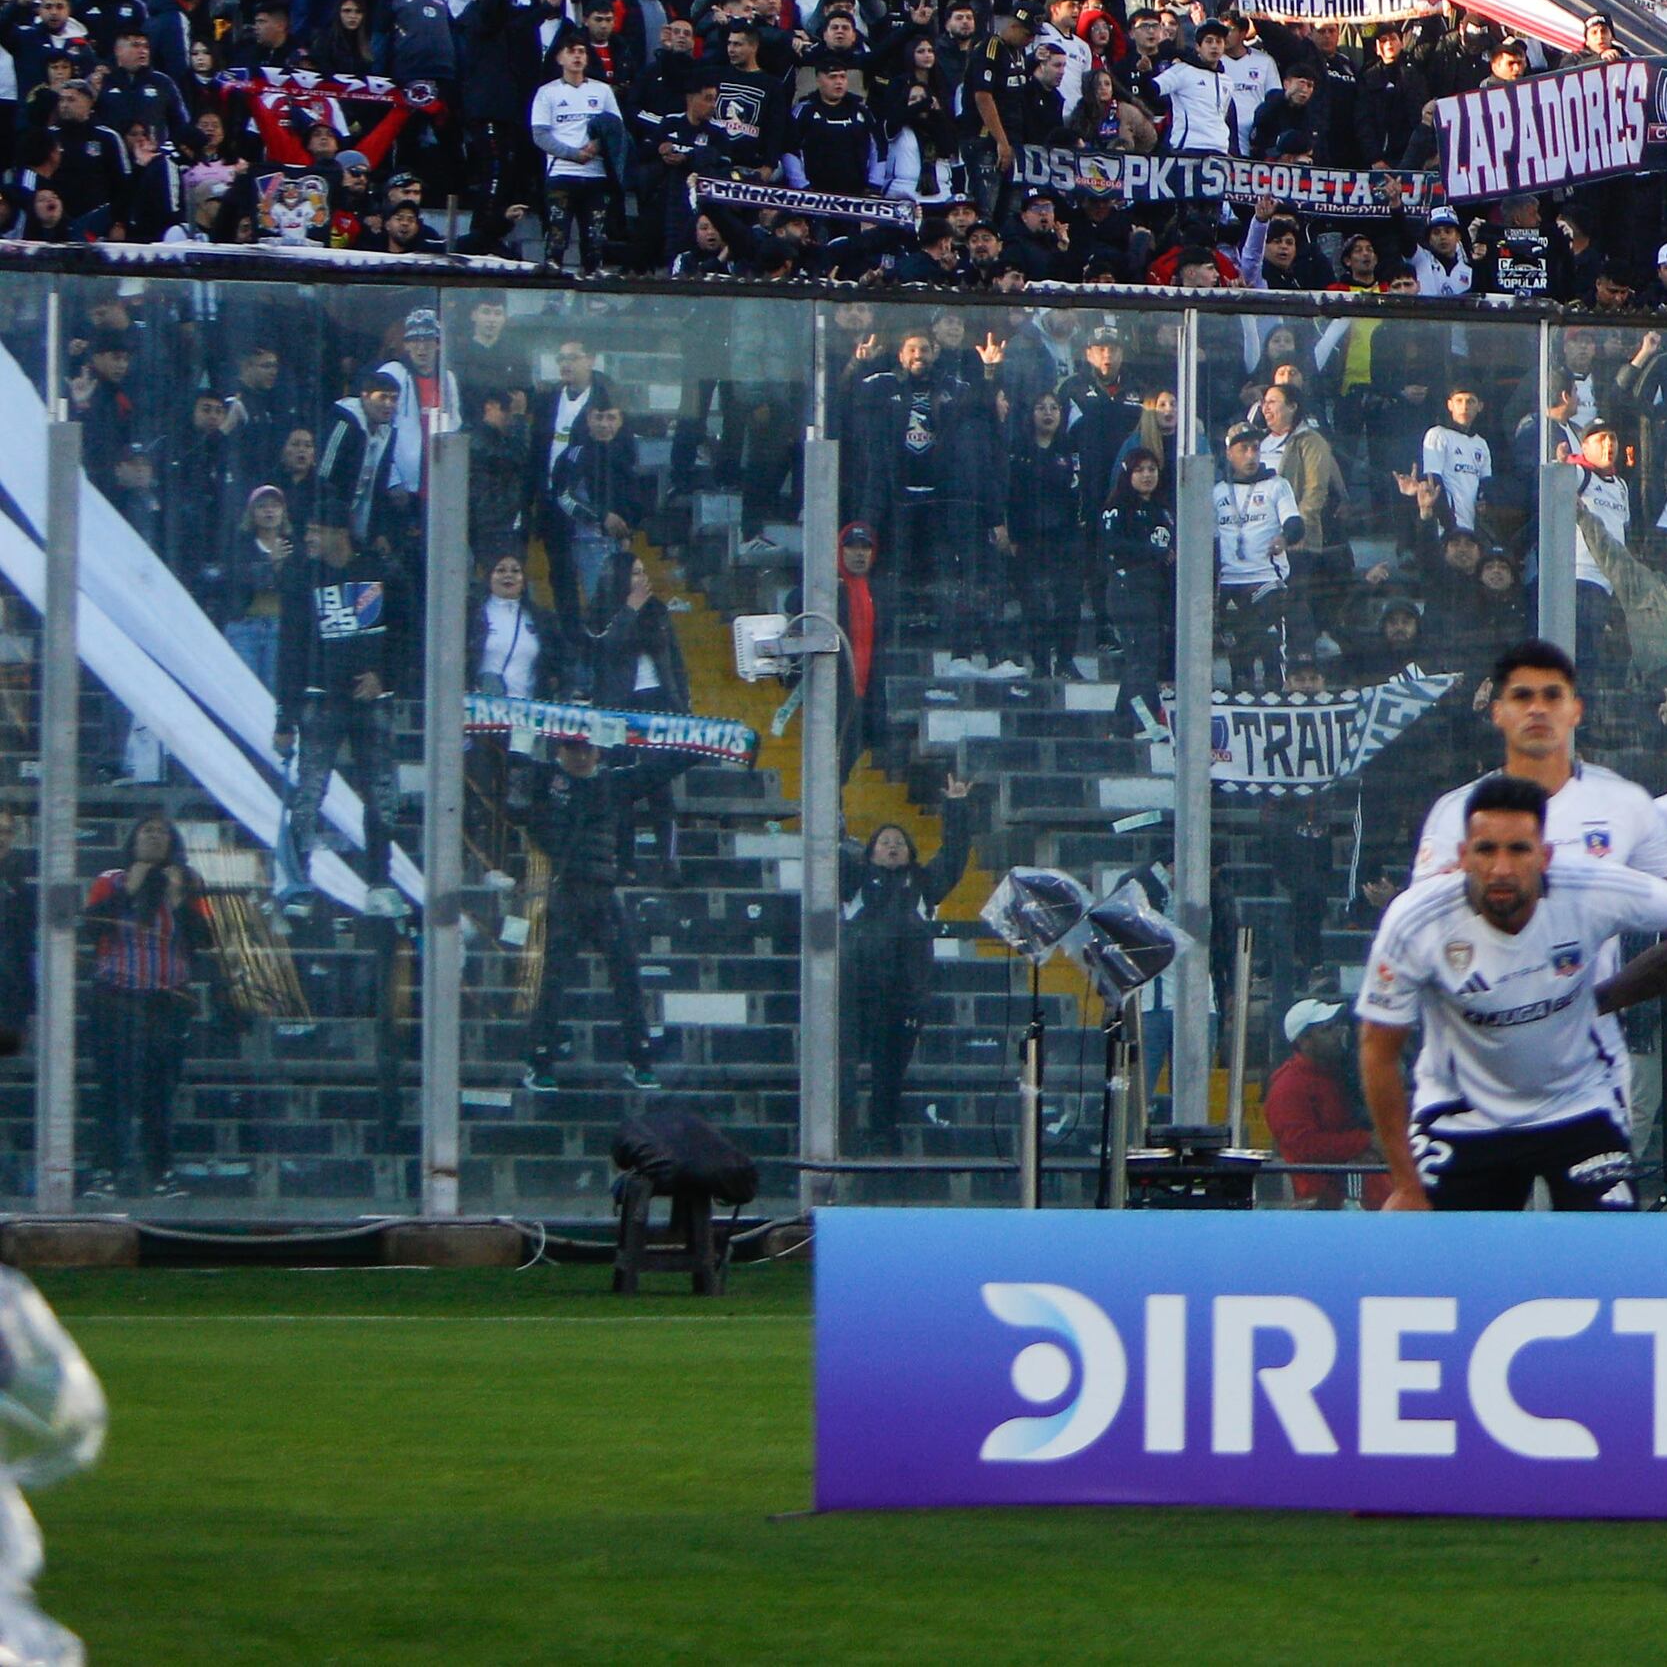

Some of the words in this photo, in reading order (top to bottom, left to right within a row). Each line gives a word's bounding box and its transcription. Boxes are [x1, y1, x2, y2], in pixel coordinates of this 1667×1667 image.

[1436, 59, 1649, 198] ZAPADORES
[1123, 152, 1226, 201] PKTS
[1497, 277, 1548, 289] POPULAR
